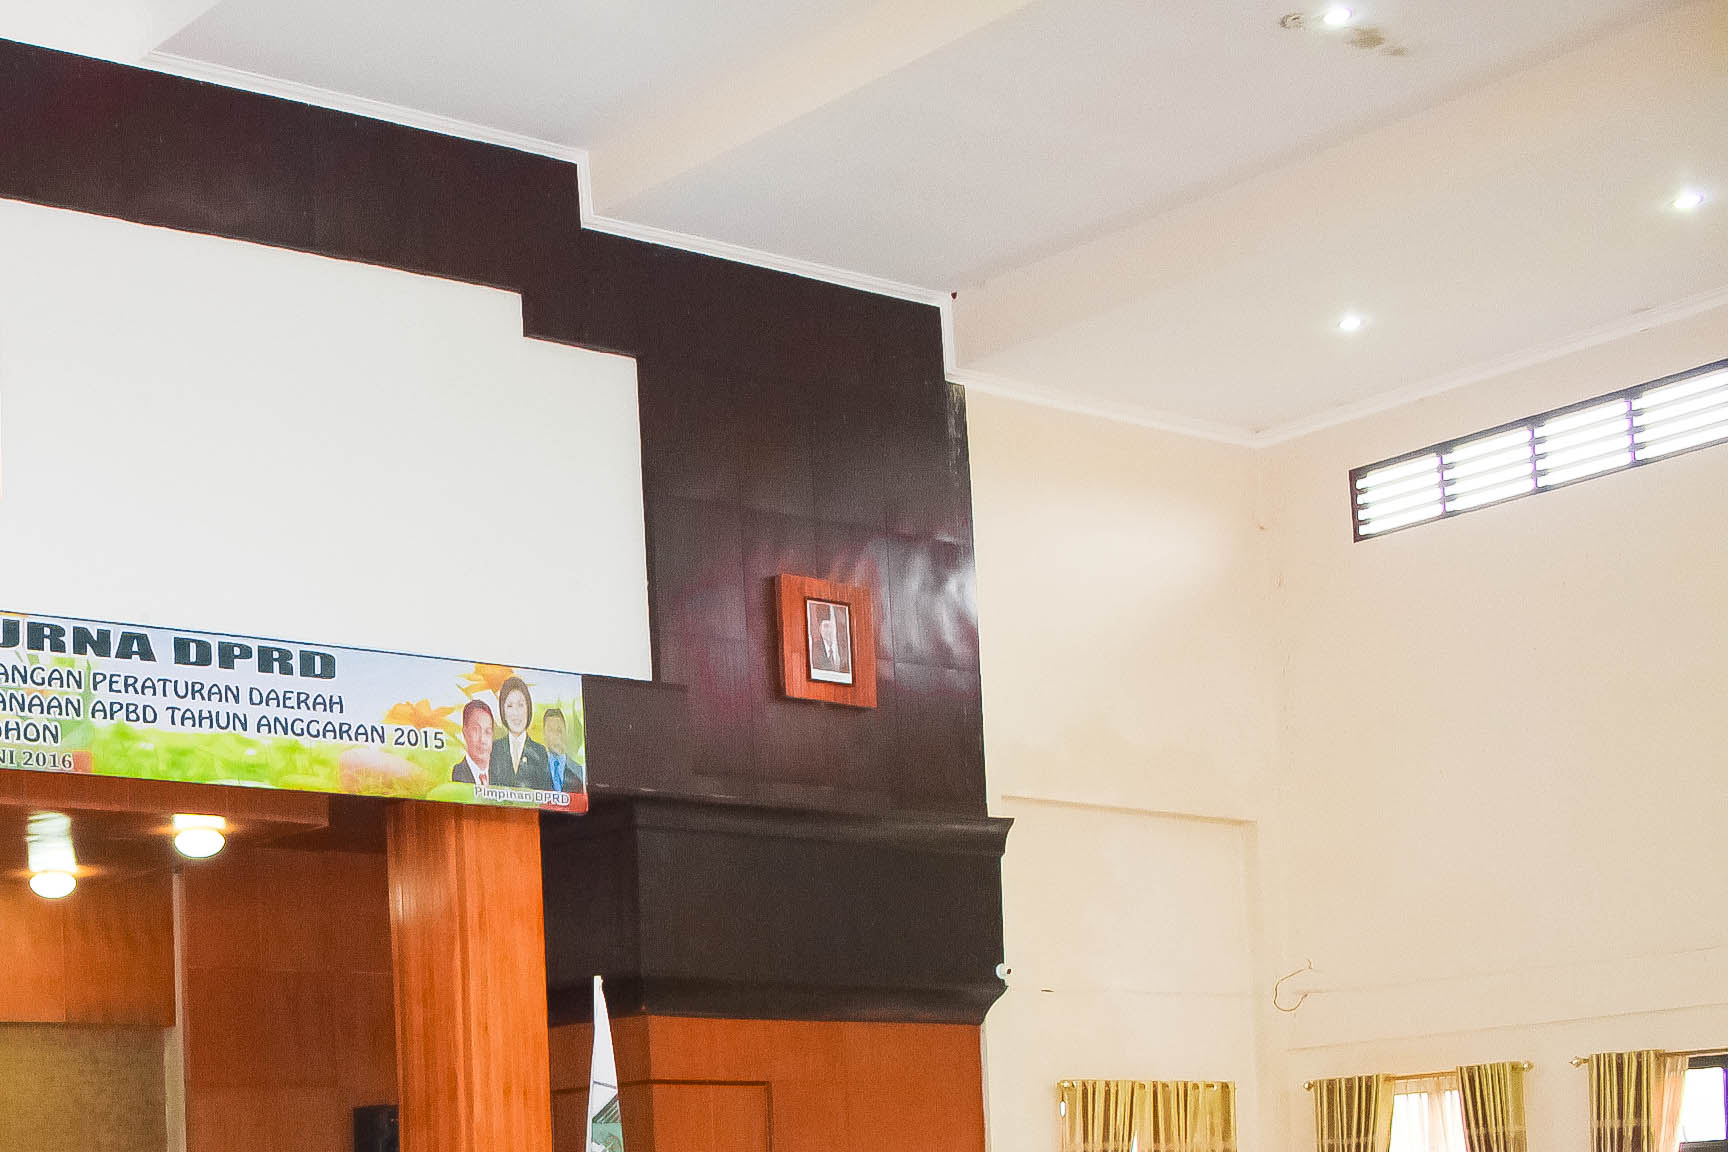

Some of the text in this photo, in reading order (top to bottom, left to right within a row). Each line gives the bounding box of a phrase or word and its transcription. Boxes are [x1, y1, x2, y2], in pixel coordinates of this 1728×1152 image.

[173, 636, 337, 680] DPRD
[92, 671, 241, 705] PERATURAN
[248, 687, 345, 715] DAERAH
[91, 701, 159, 725] APBD
[166, 706, 249, 732] TAHUN
[256, 716, 386, 745] ANGGARAN
[394, 727, 446, 750] 2015
[22, 751, 74, 770] 2016
[474, 786, 570, 805] Pimpinan DPRD
